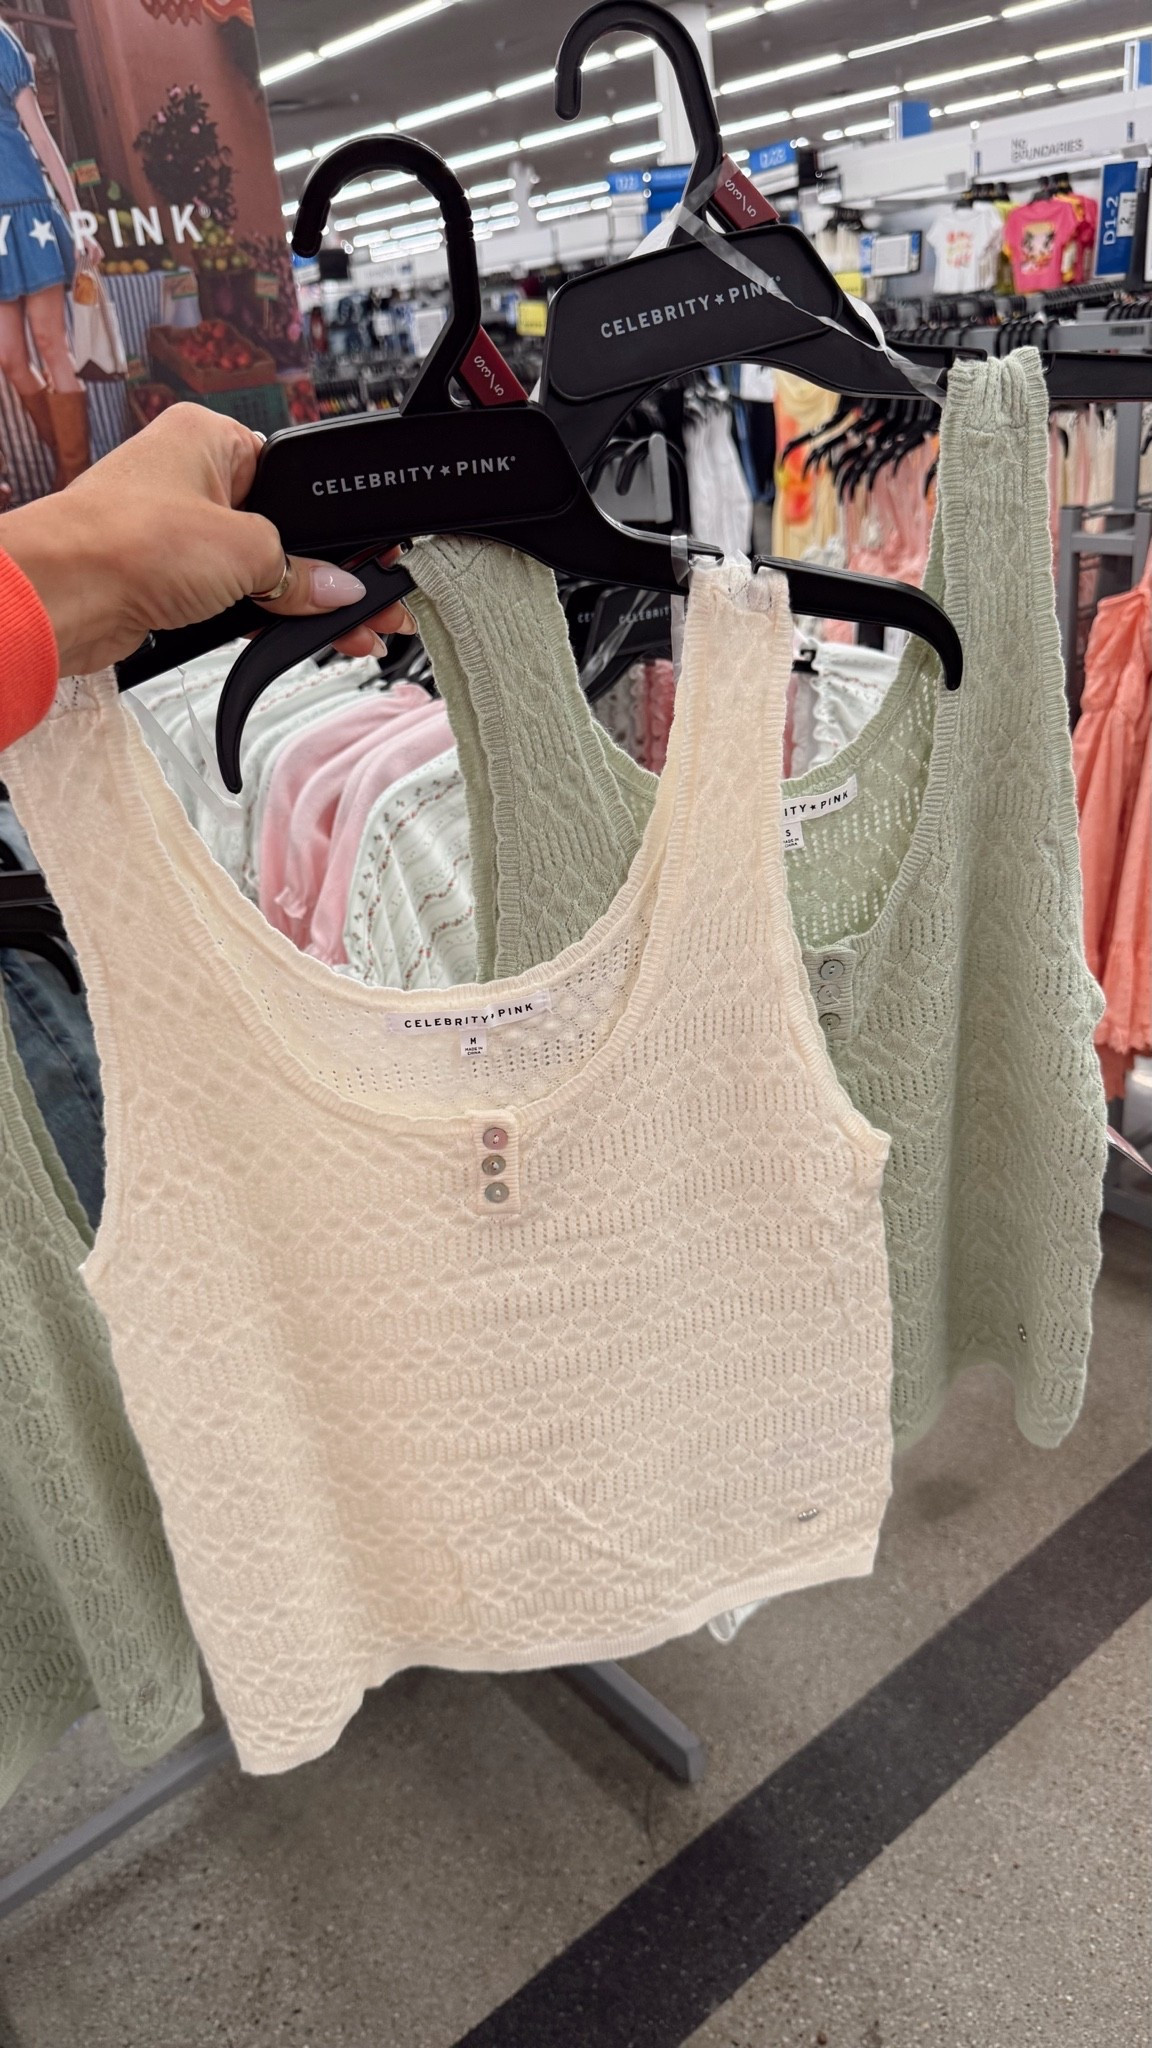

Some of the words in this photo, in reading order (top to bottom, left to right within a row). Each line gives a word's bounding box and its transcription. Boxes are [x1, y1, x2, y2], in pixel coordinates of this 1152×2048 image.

[1103, 196, 1119, 245] D1-2
[600, 295, 710, 339] CELEBRITY
[728, 276, 774, 304] PIN
[311, 464, 435, 496] CELEBRITY
[820, 790, 849, 810] PINK
[785, 829, 792, 837] S
[404, 1014, 489, 1029] CELEBRITY
[498, 1002, 534, 1018] PINK
[470, 1037, 477, 1045] M
